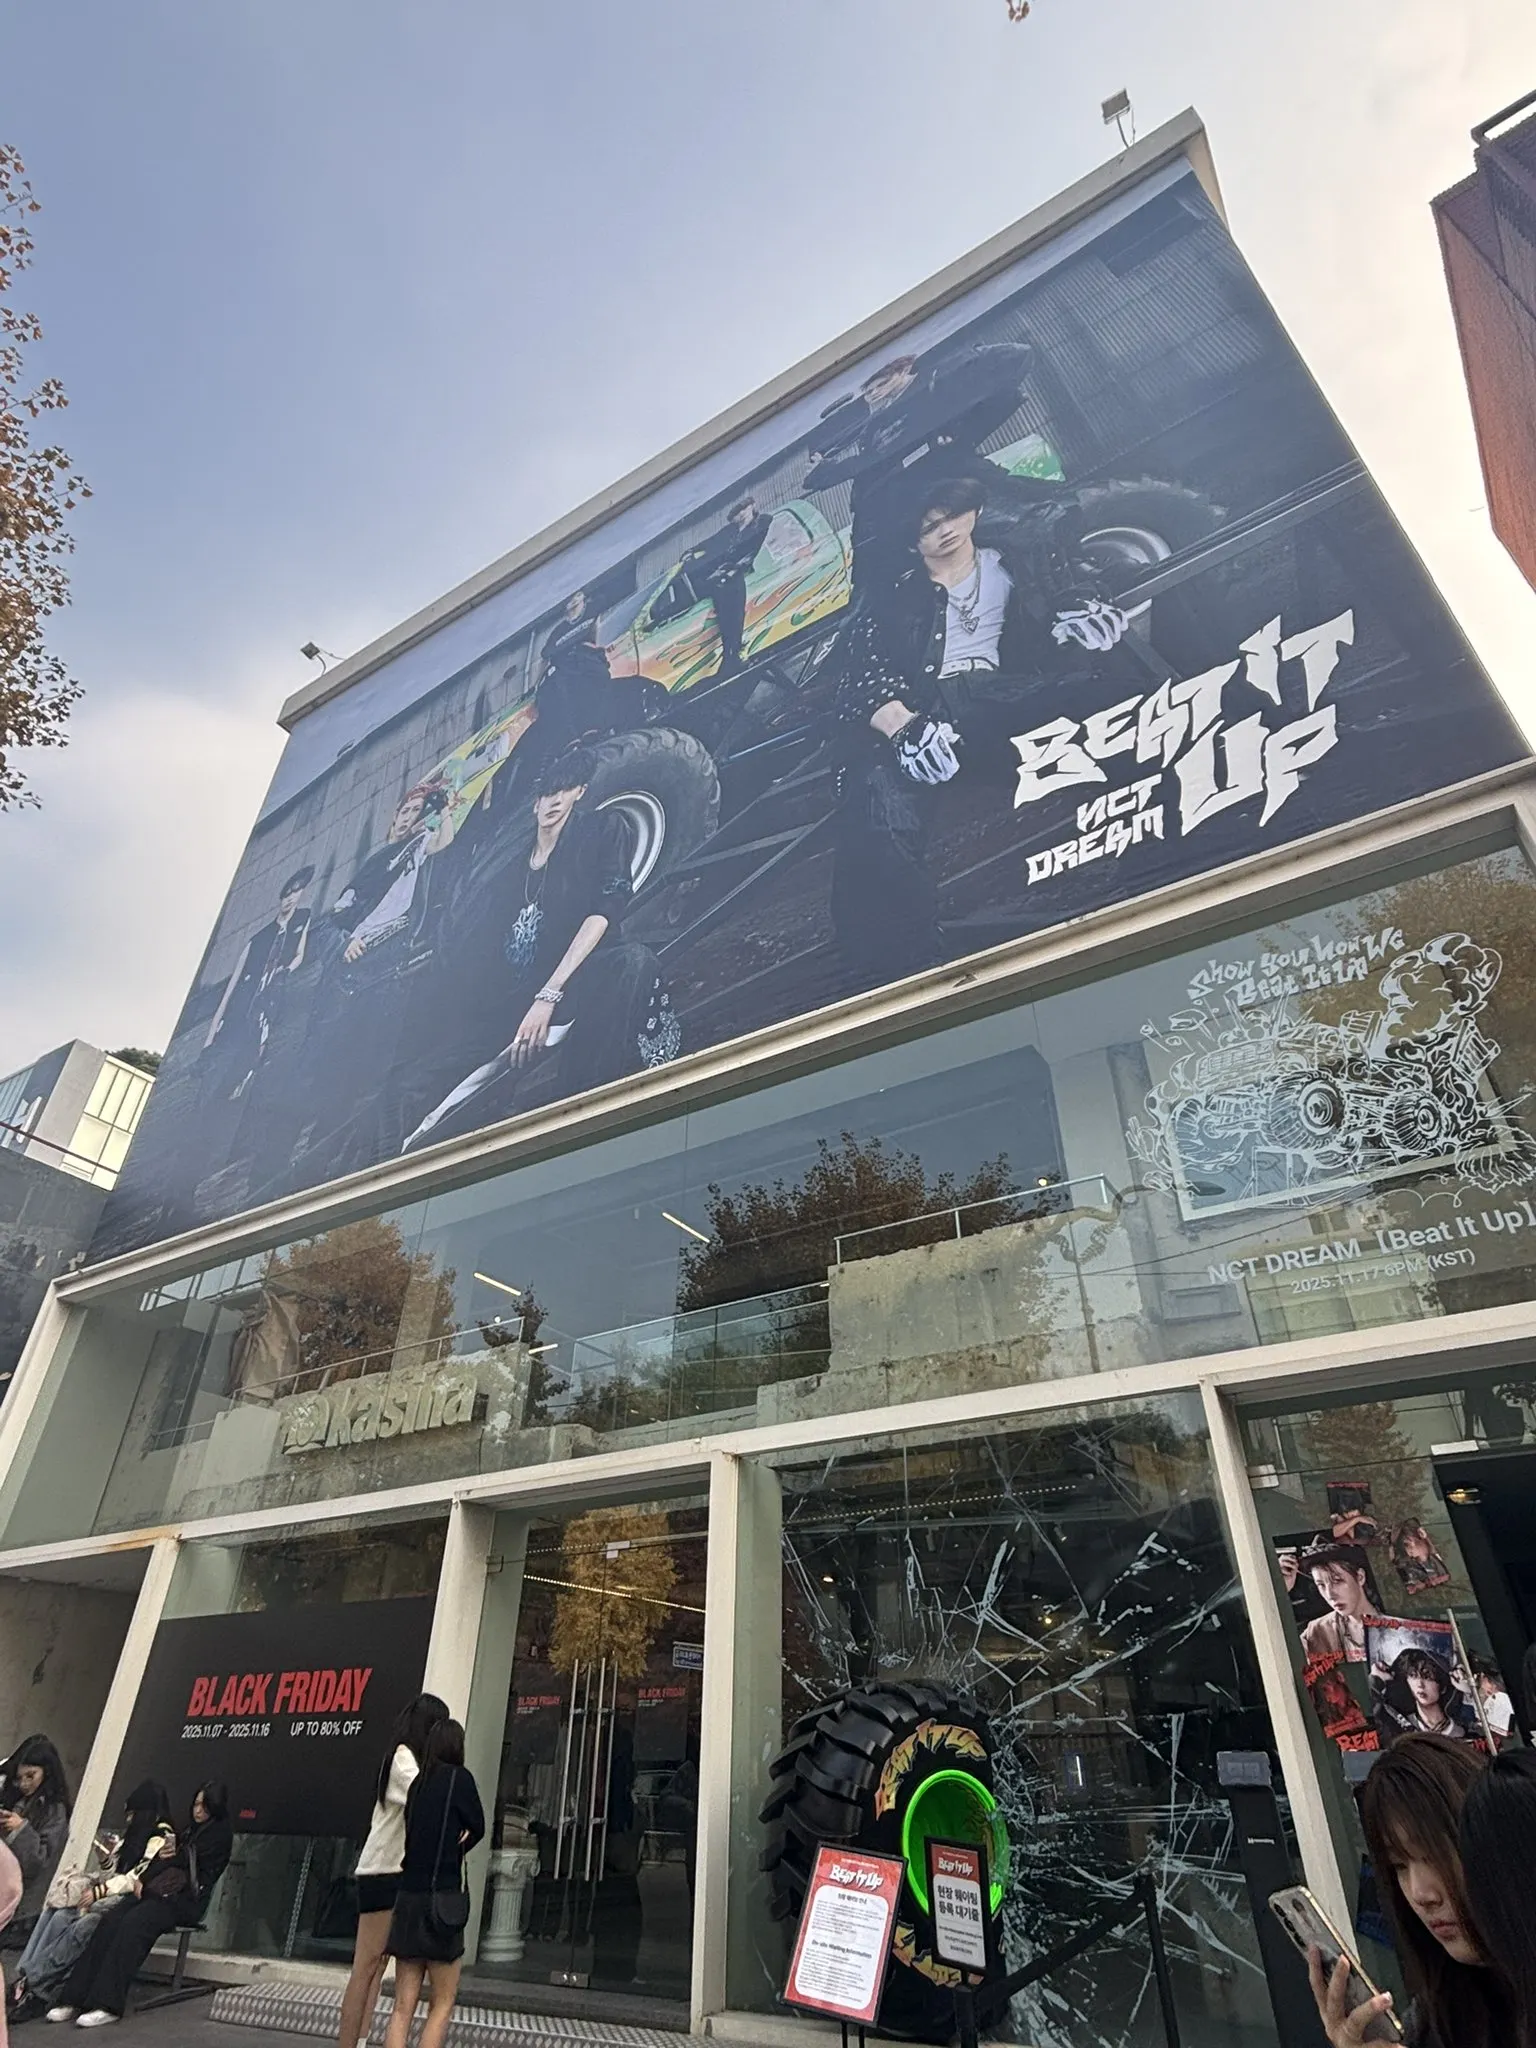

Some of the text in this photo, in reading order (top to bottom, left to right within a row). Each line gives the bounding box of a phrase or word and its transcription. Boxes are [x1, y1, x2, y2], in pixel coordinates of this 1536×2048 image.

[1010, 609, 1354, 809] BEAT IT
[1174, 704, 1339, 836] UP
[1077, 774, 1162, 832] NCT
[1026, 804, 1165, 885] DREAM
[1187, 959, 1255, 1000] Show
[1207, 1256, 1260, 1285] NCT
[1266, 1238, 1363, 1275] DREAM
[1456, 1217, 1480, 1238] It
[1291, 1248, 1476, 1294] 2025.11.17 6PM (KST)
[187, 1668, 373, 1716] BLACK FRIDAY
[181, 1724, 224, 1738] 2025.11.07
[228, 1723, 270, 1737] 2025.11.16
[290, 1722, 304, 1736] UP
[306, 1721, 319, 1736] TO
[320, 1721, 341, 1736] 80%
[342, 1720, 362, 1736] OFF
[829, 1864, 857, 1884] BEAT
